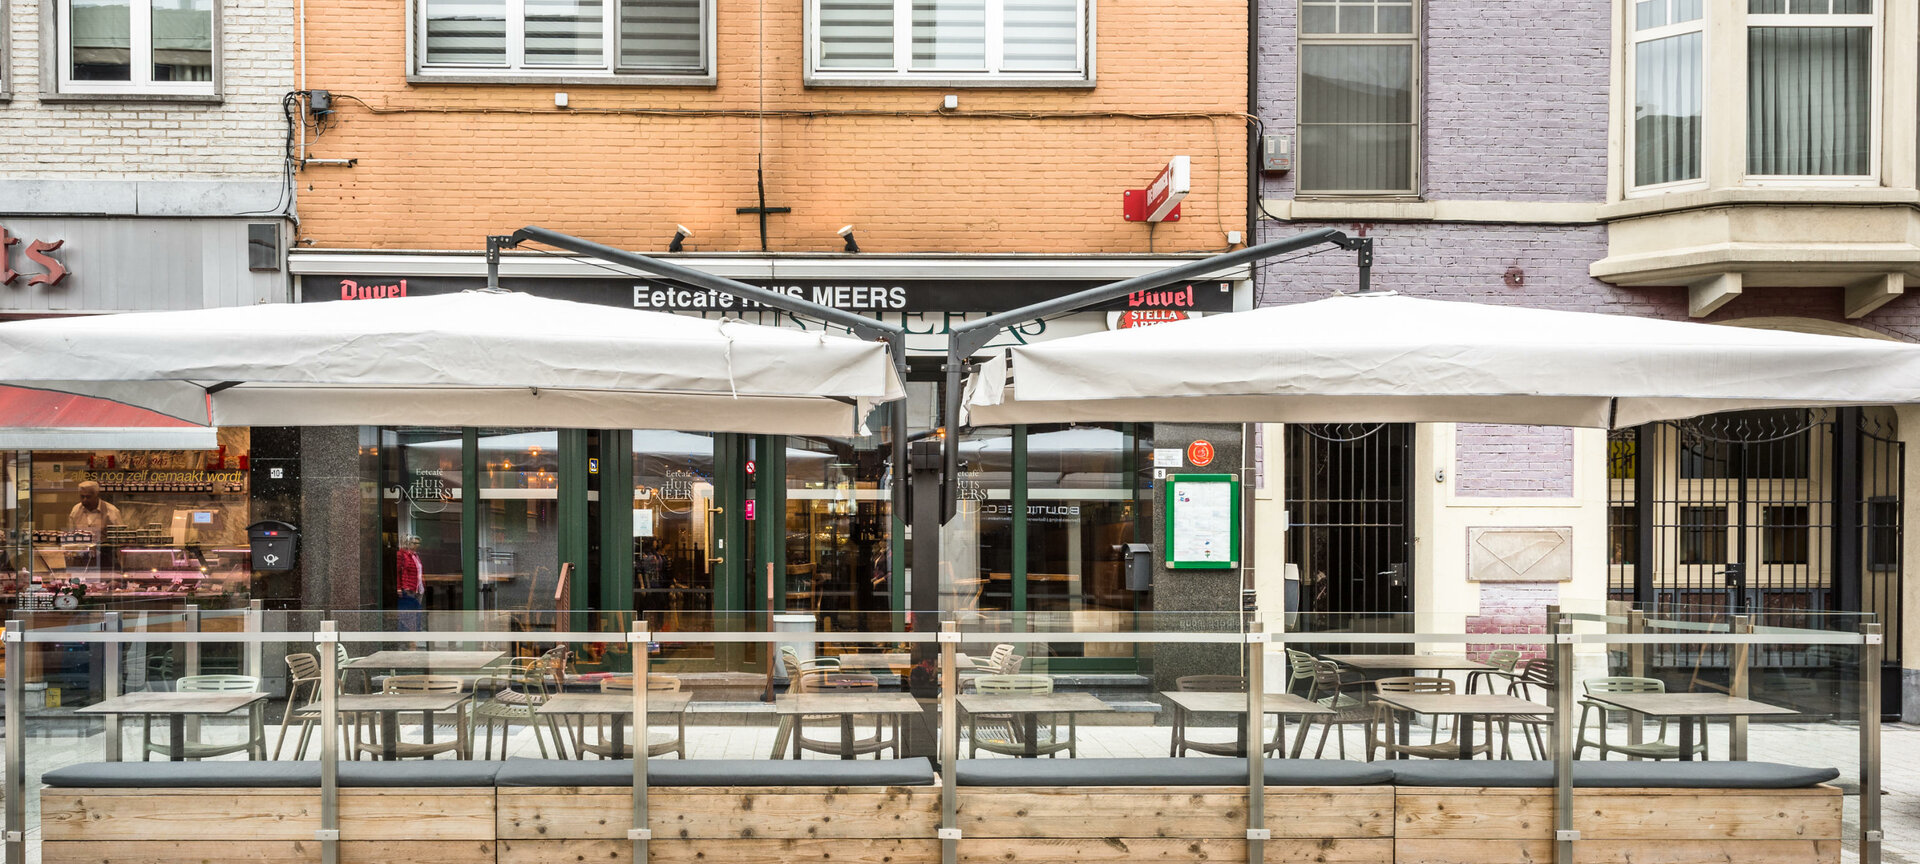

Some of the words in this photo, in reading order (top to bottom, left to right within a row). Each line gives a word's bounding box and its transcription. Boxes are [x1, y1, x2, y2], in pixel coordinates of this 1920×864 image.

[812, 286, 907, 309] MEERS
[1131, 310, 1178, 320] STELLA
[100, 472, 124, 484] nog
[126, 469, 149, 482] zelf
[149, 469, 204, 484] gemaakt
[411, 476, 444, 488] HUIS
